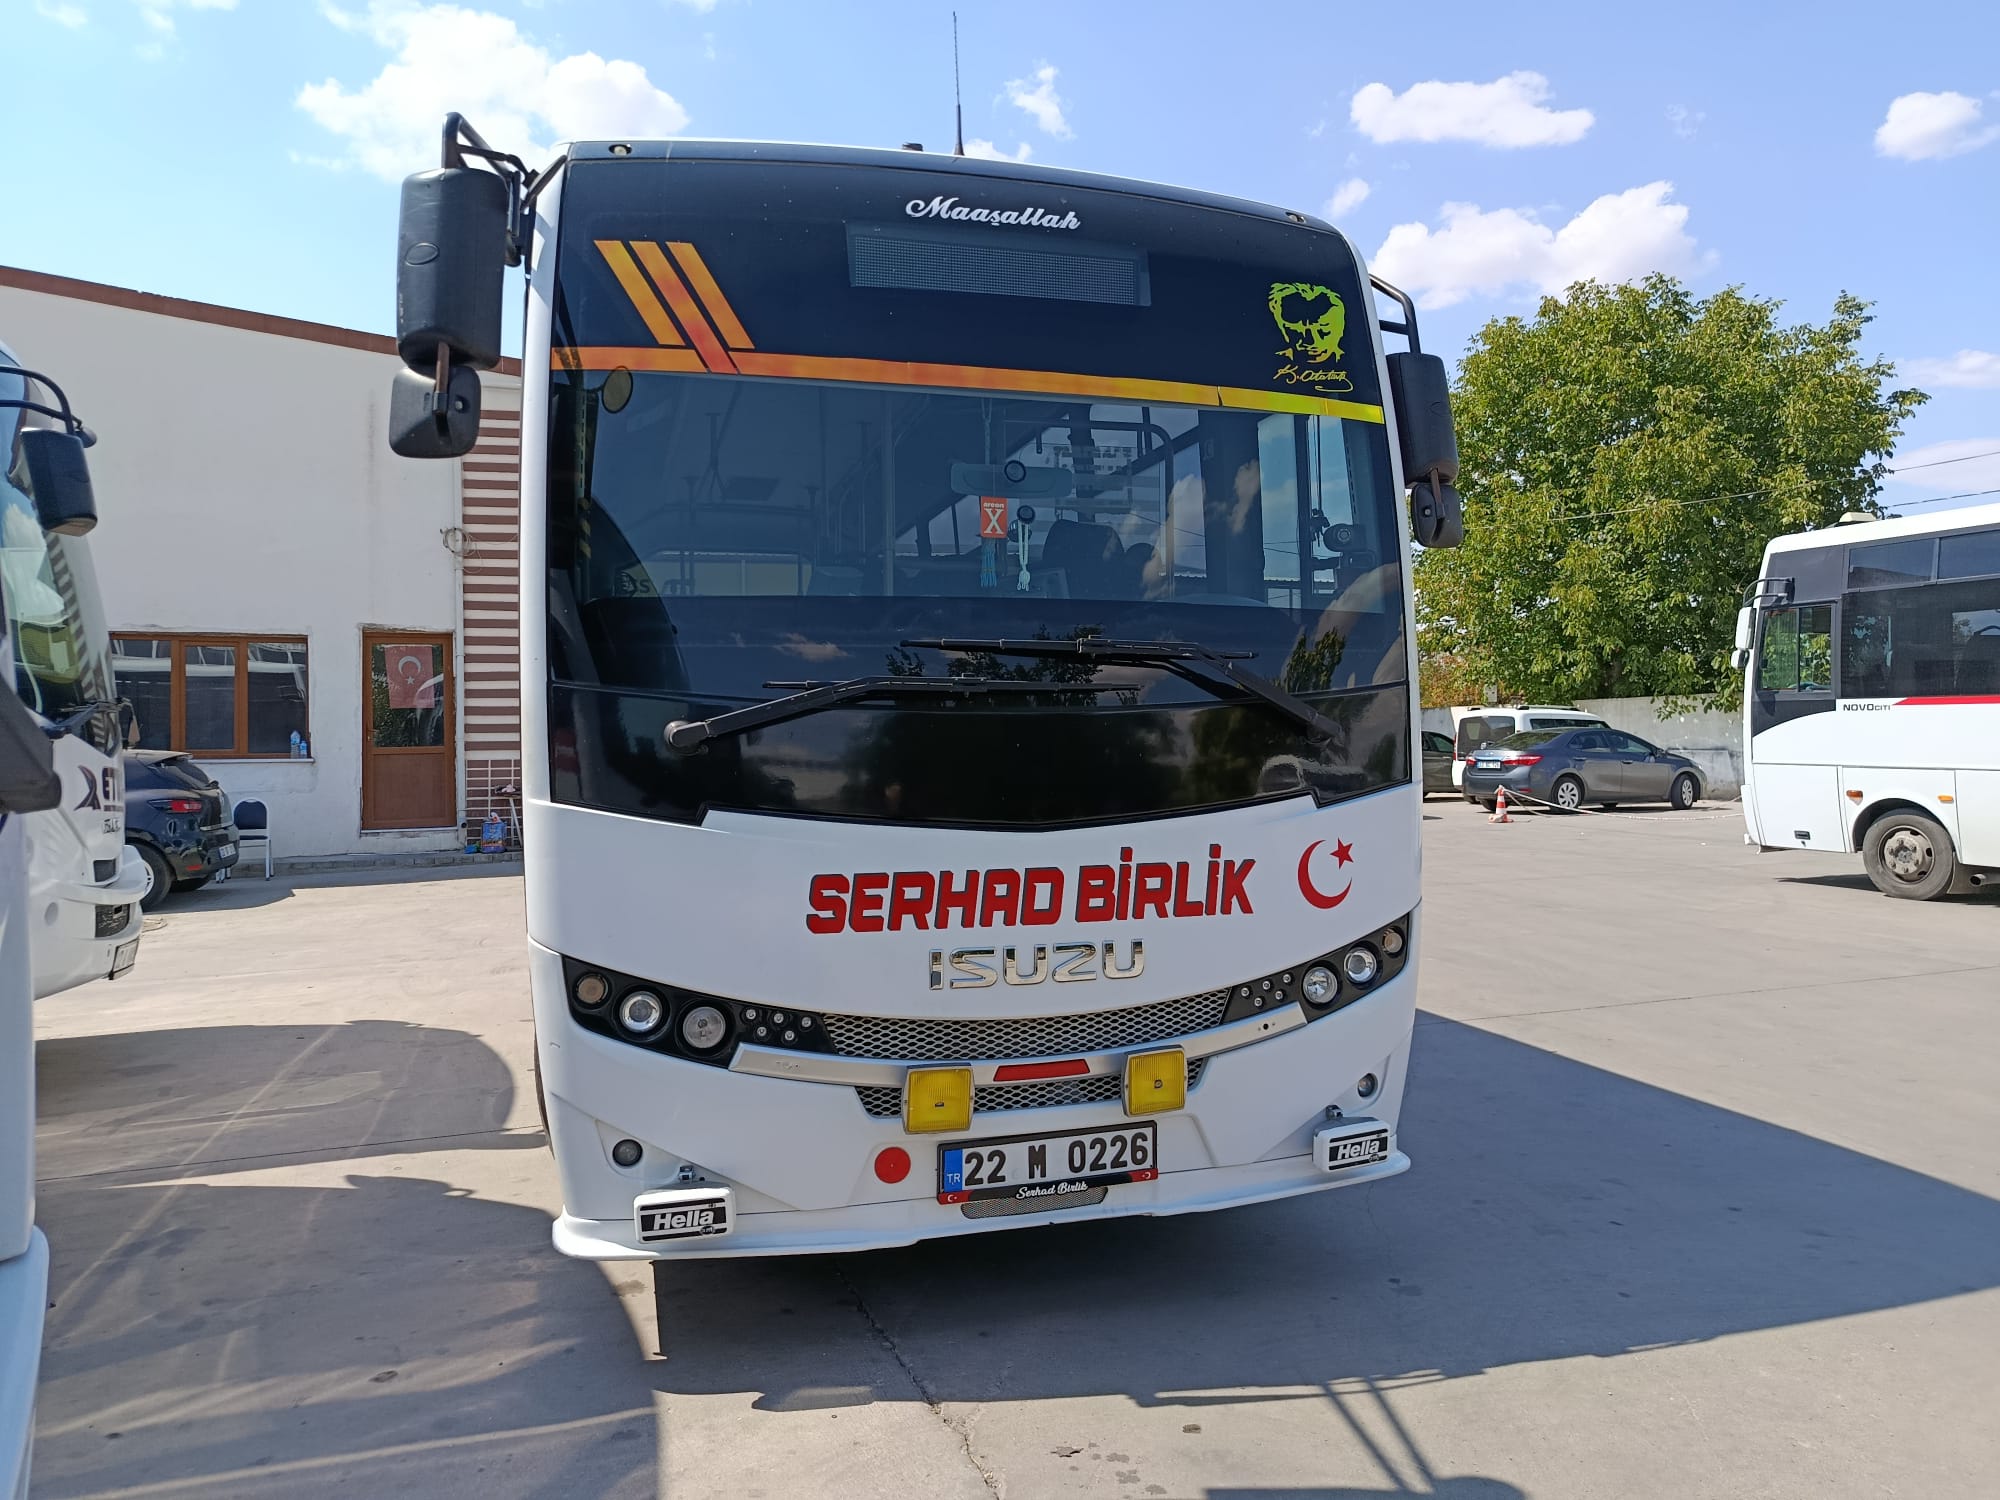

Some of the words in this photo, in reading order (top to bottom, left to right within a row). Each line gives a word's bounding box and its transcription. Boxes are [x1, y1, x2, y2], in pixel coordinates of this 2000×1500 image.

[906, 196, 1081, 230] Maaşallah
[983, 508, 1005, 534] X
[806, 867, 1066, 934] SERHAD
[1075, 843, 1257, 923] BİRLİK
[929, 938, 1145, 990] ISUZU
[946, 1172, 961, 1184] TR
[964, 1149, 1007, 1187] 22
[1028, 1144, 1047, 1180] M
[1068, 1132, 1148, 1174] 0226
[1337, 1140, 1379, 1160] Hella
[1016, 1185, 1056, 1199] Serhad
[653, 1210, 714, 1230] Hella
